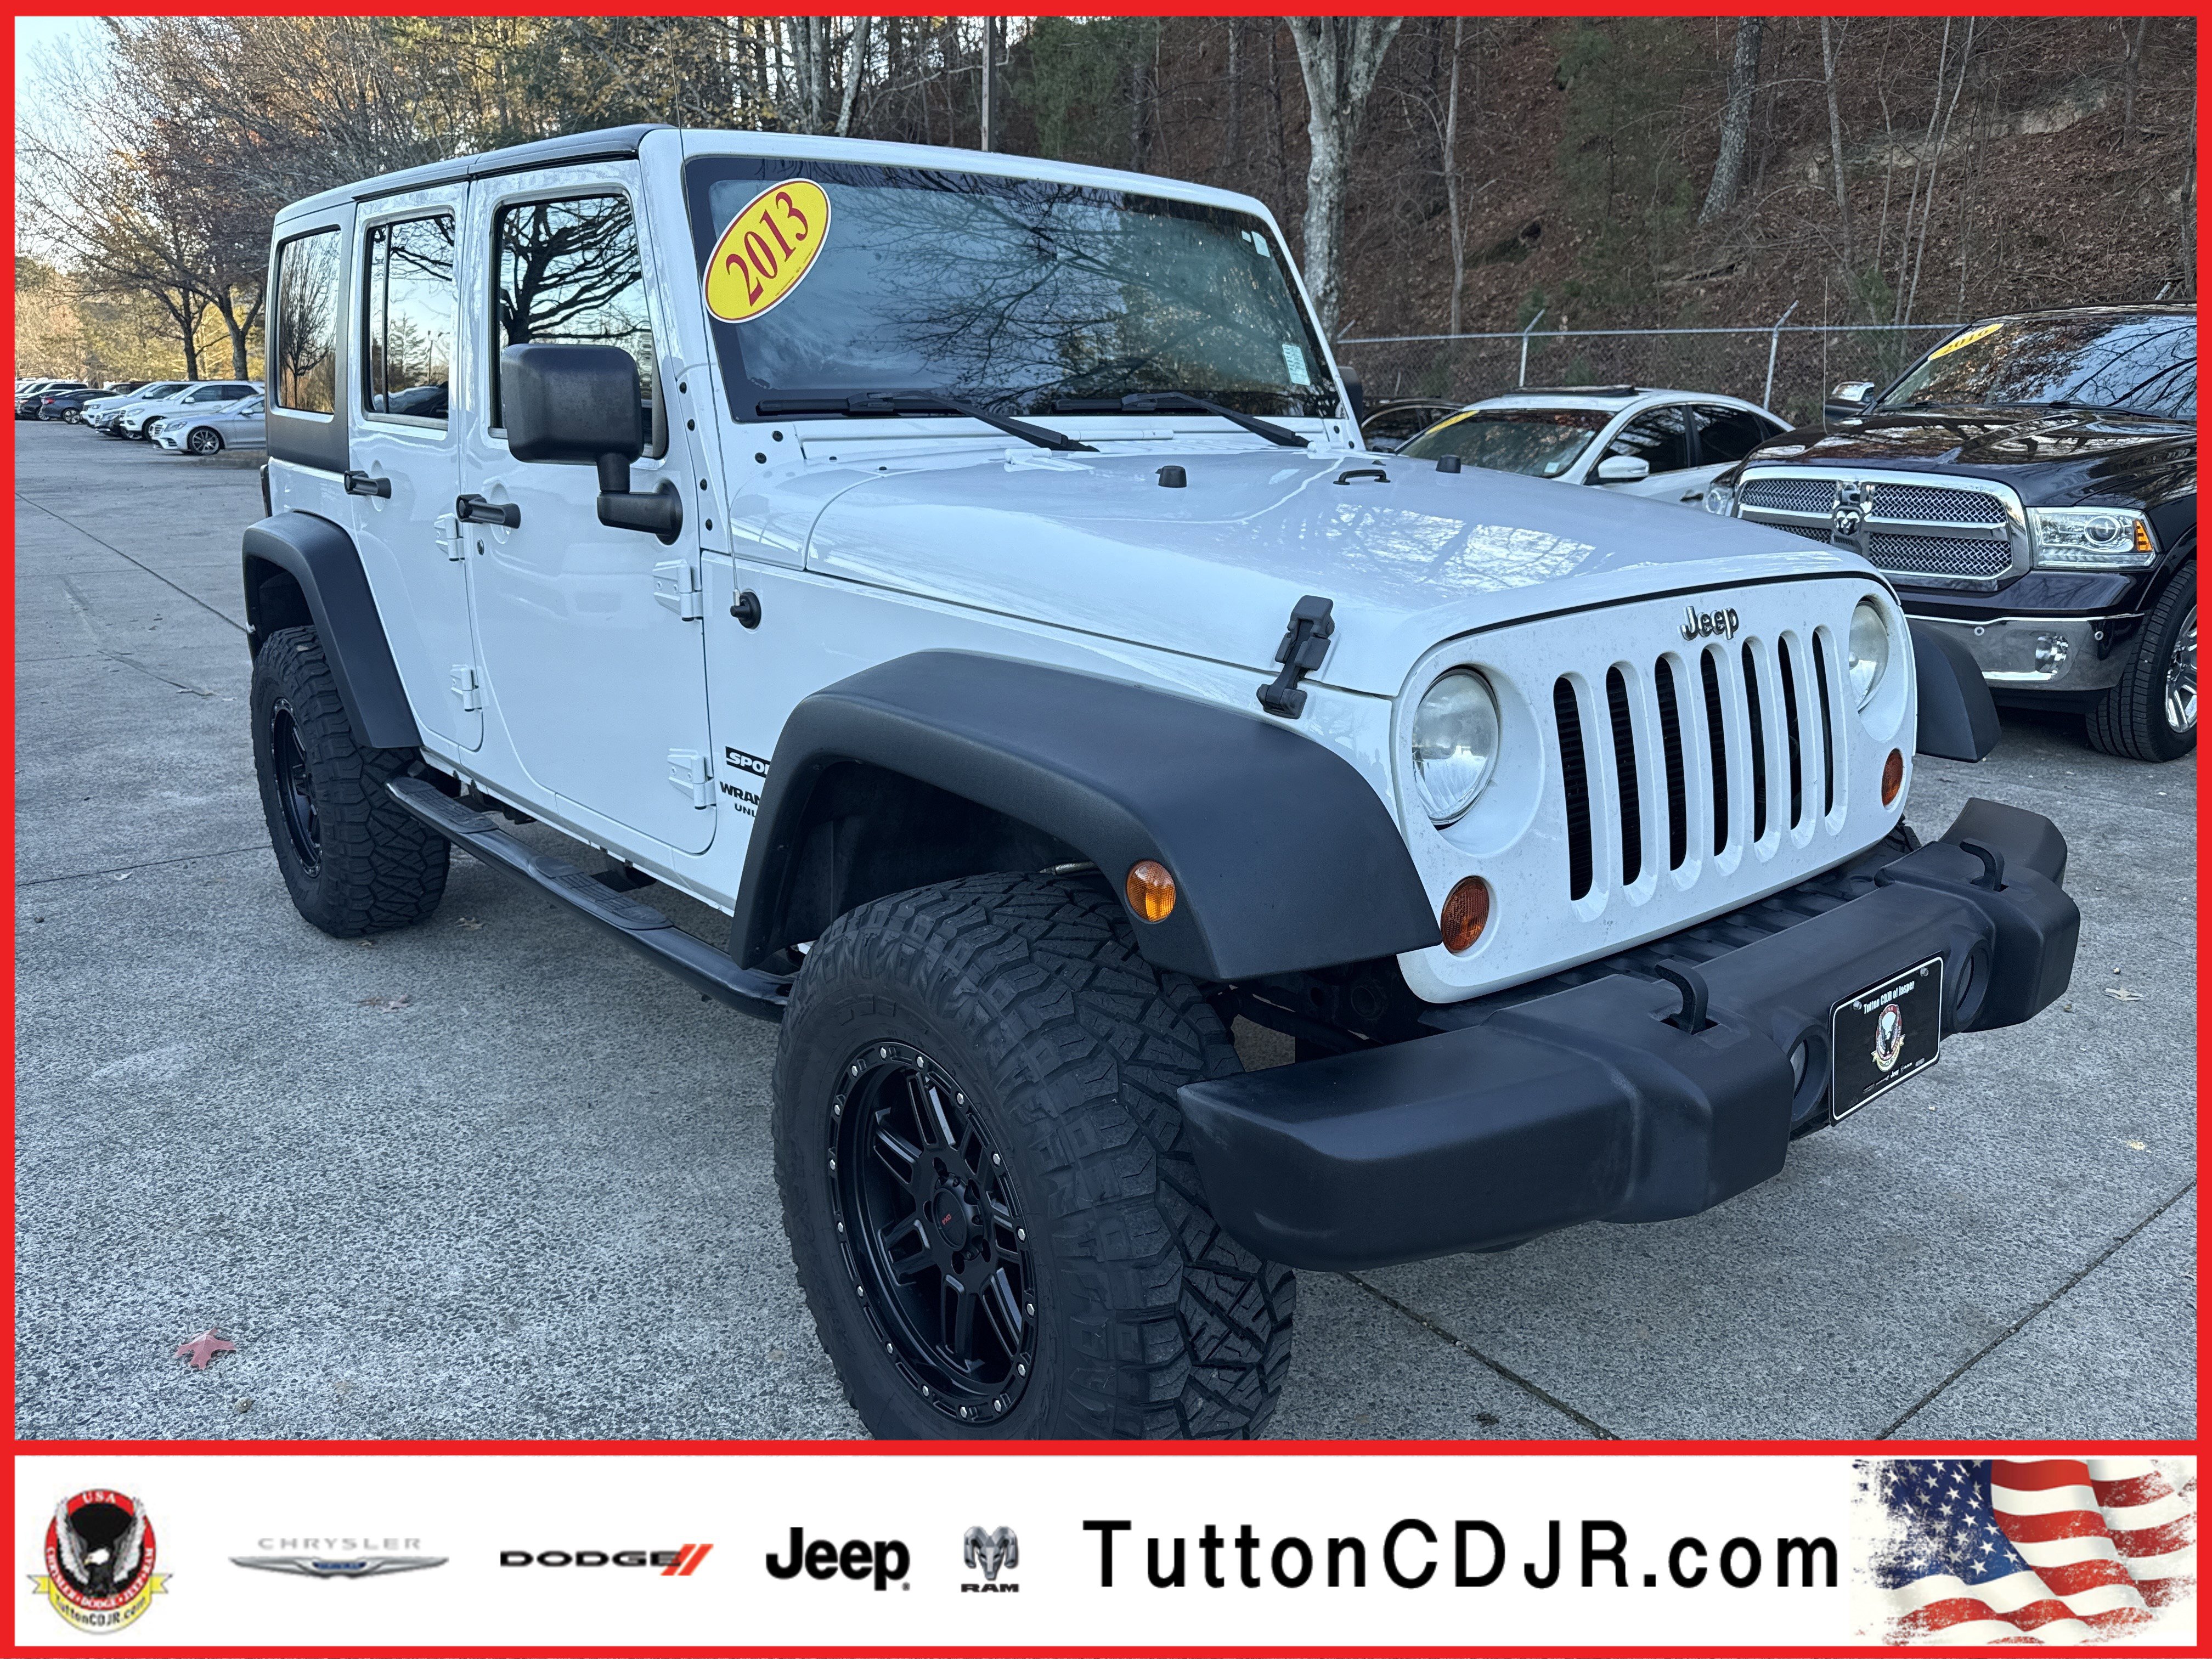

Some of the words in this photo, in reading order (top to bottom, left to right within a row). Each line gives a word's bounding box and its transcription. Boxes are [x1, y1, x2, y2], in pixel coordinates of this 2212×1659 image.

[725, 191, 809, 307] 2013
[1680, 606, 1739, 641] Jeep
[1863, 998, 1880, 1014] Tutton
[1880, 990, 1892, 1006] CDJR
[1893, 987, 1898, 999] of
[1898, 980, 1915, 996] Jasper
